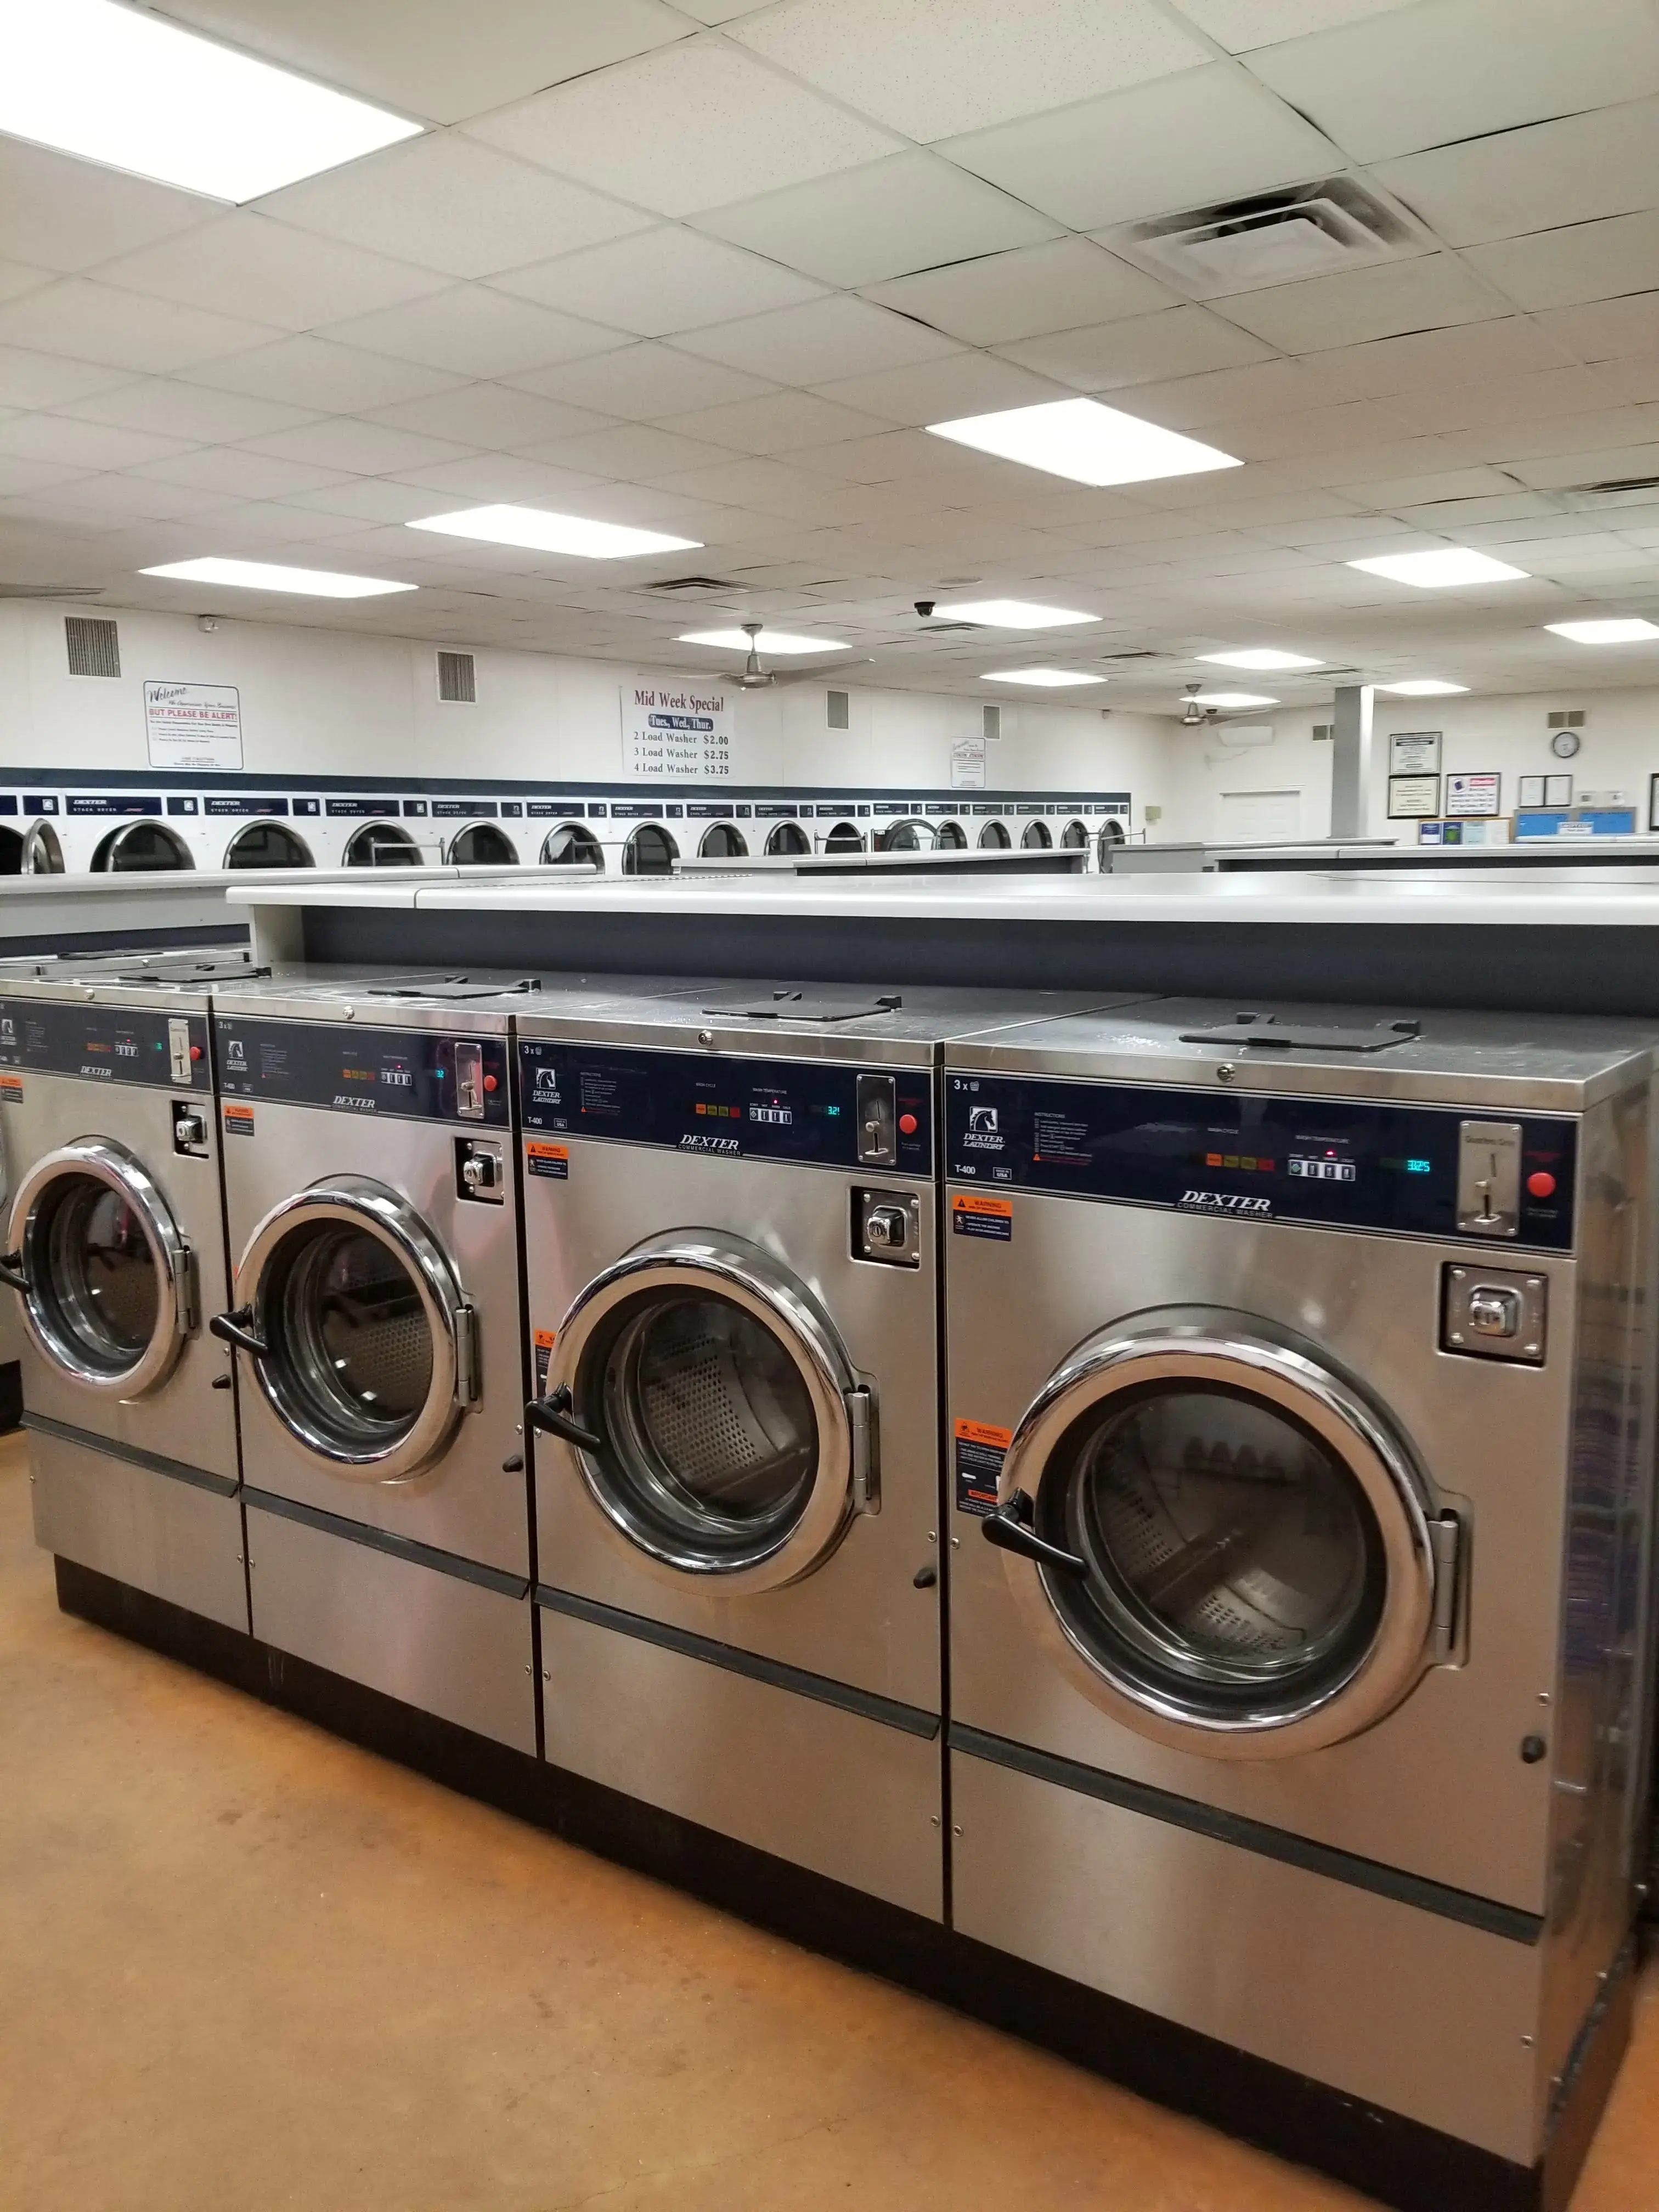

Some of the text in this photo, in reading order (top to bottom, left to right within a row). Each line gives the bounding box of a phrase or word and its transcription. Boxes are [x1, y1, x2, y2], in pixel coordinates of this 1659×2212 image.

[149, 687, 187, 702] Welcome
[634, 690, 724, 714] Mid Week Special
[692, 719, 711, 730] Thur.
[634, 731, 729, 745] 2 Load Washer $2.00
[634, 747, 729, 760] 3 Load Washer $2.75
[634, 763, 729, 774] 4 Load Washer $3.75
[524, 1045, 529, 1054] 3
[80, 1065, 112, 1076] DEXTER
[953, 1080, 960, 1090] 3
[532, 1090, 560, 1098] DEXTER
[332, 1096, 375, 1108] DEXTER
[528, 1116, 542, 1125] T-400
[680, 1134, 739, 1150] DEXTER
[963, 1133, 1003, 1143] DEXTER
[678, 1144, 715, 1153] COMMERCIAL
[963, 1141, 1005, 1150] LAUNDRY
[955, 1164, 976, 1175] T-400
[1180, 1190, 1271, 1211] DEXTER
[1177, 1202, 1273, 1218] COMMERCIAL WASHER
